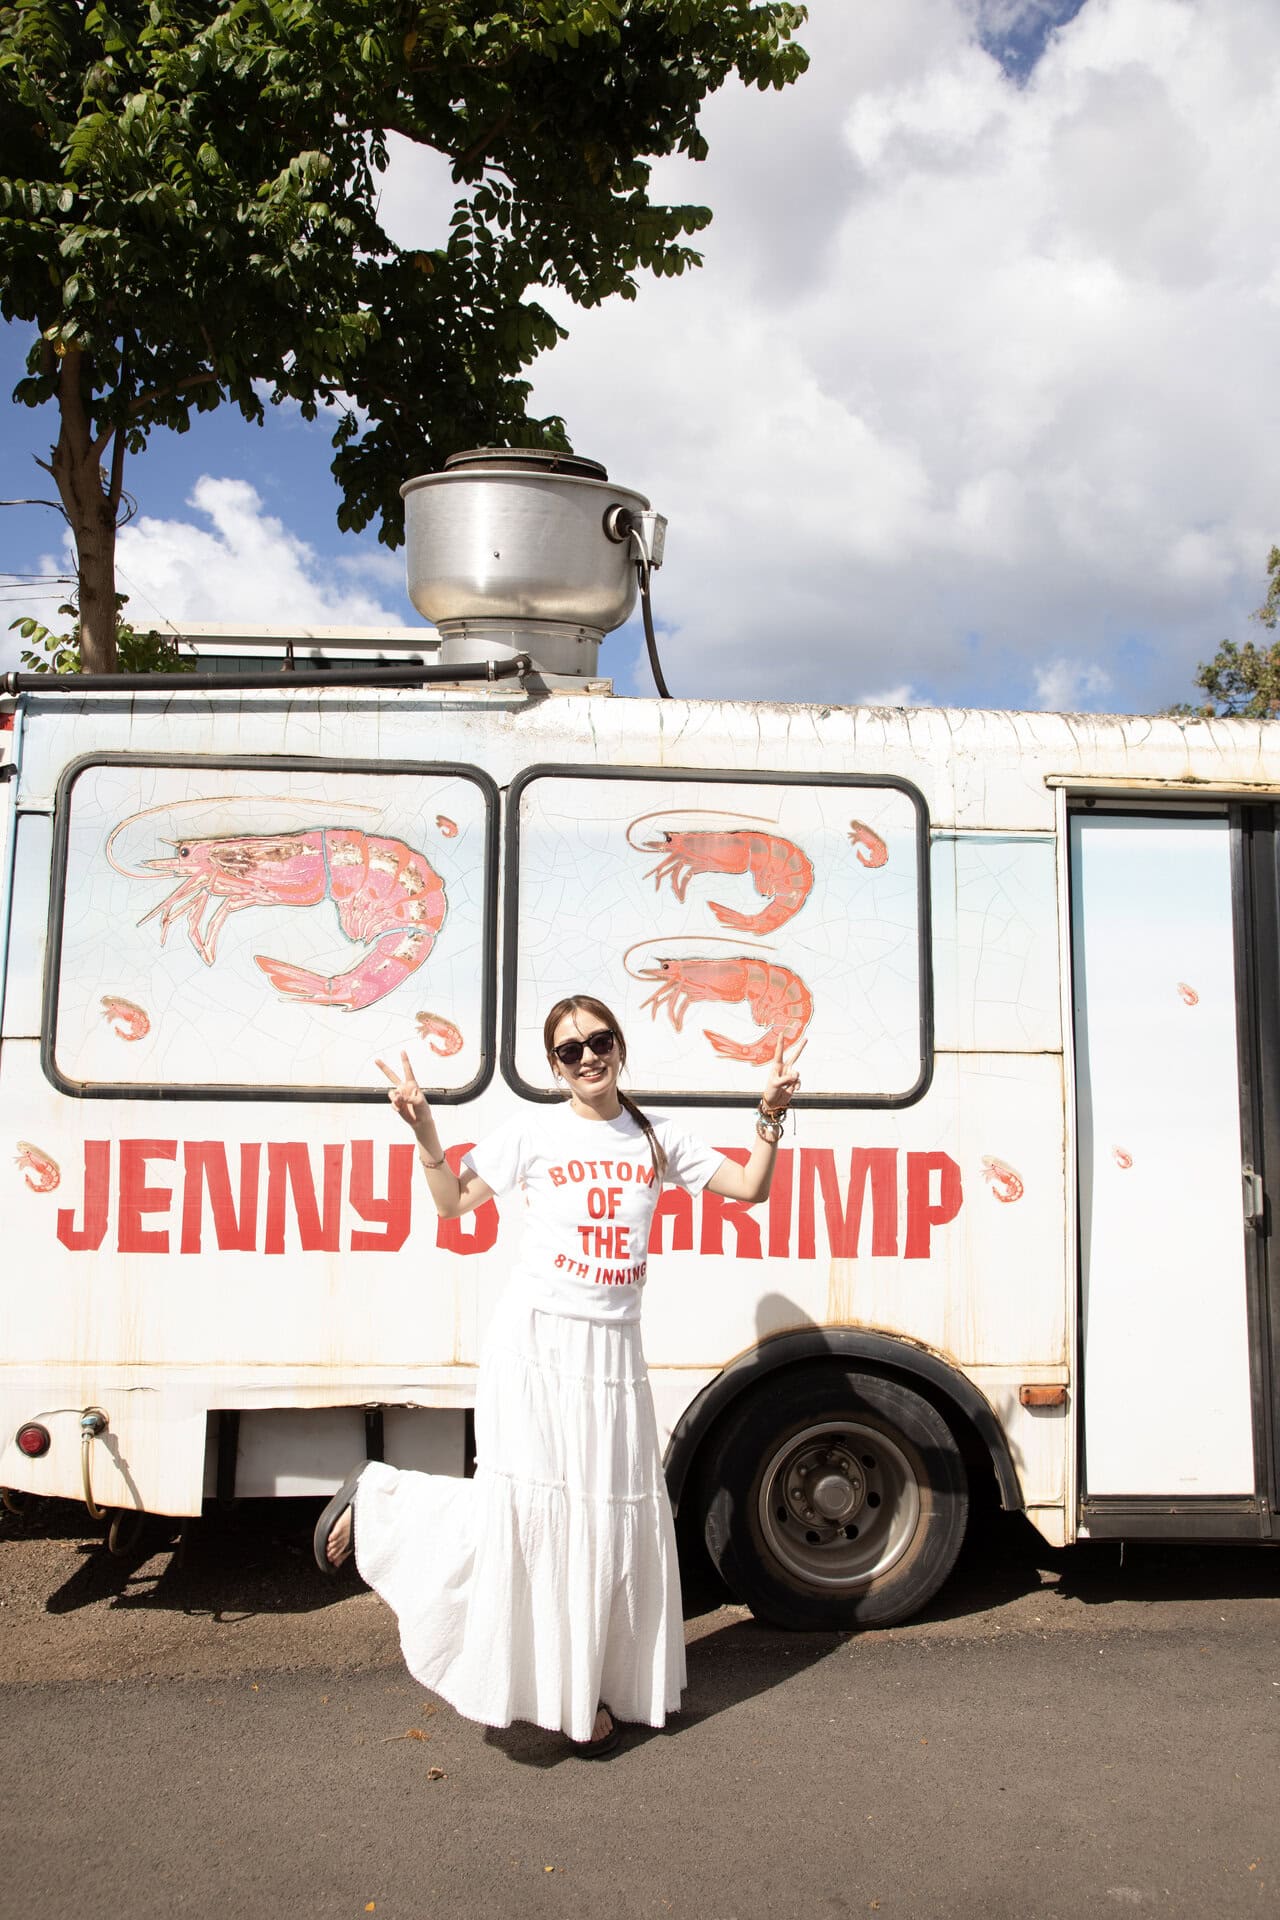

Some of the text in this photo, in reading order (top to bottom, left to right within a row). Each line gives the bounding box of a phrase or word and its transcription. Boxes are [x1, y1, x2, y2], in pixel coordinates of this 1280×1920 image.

[548, 1159, 656, 1189] BOTTOM
[587, 1187, 624, 1220] OF
[577, 1225, 631, 1260] THE
[553, 1253, 647, 1286] 8TH INNING
